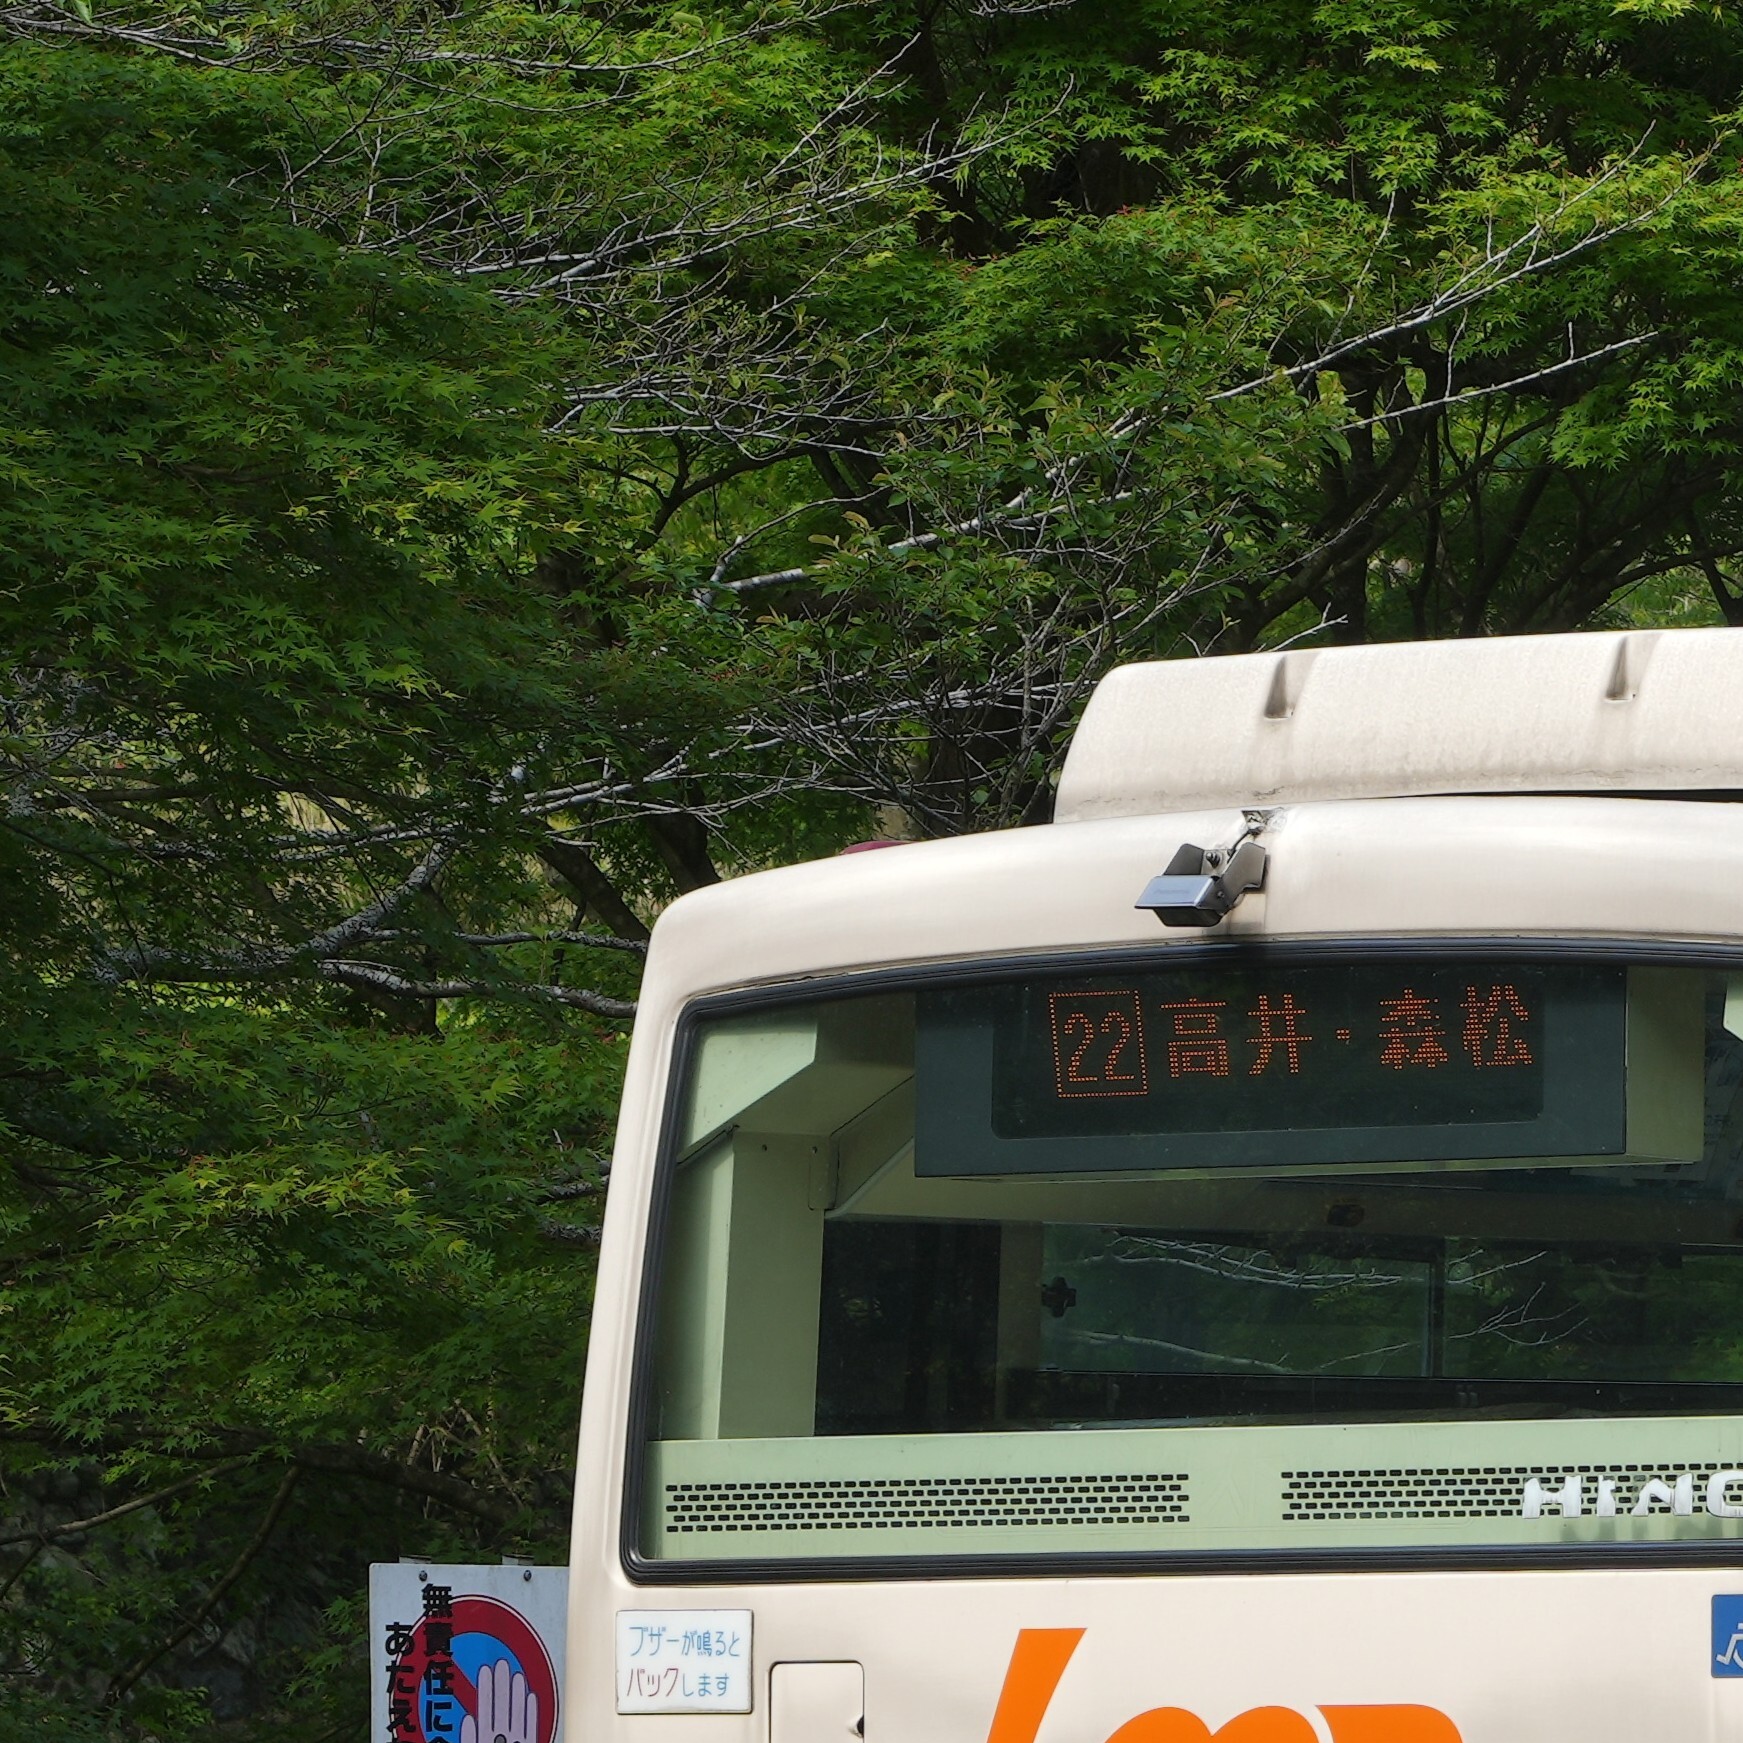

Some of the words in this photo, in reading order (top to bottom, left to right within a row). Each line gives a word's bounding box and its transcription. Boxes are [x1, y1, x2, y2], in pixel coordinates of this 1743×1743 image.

[1063, 1010, 1136, 1083] 22
[1160, 983, 1534, 1079] 高井・森松
[629, 1625, 741, 1658] ブザーが鳴ると
[626, 1667, 730, 1698] バックします
